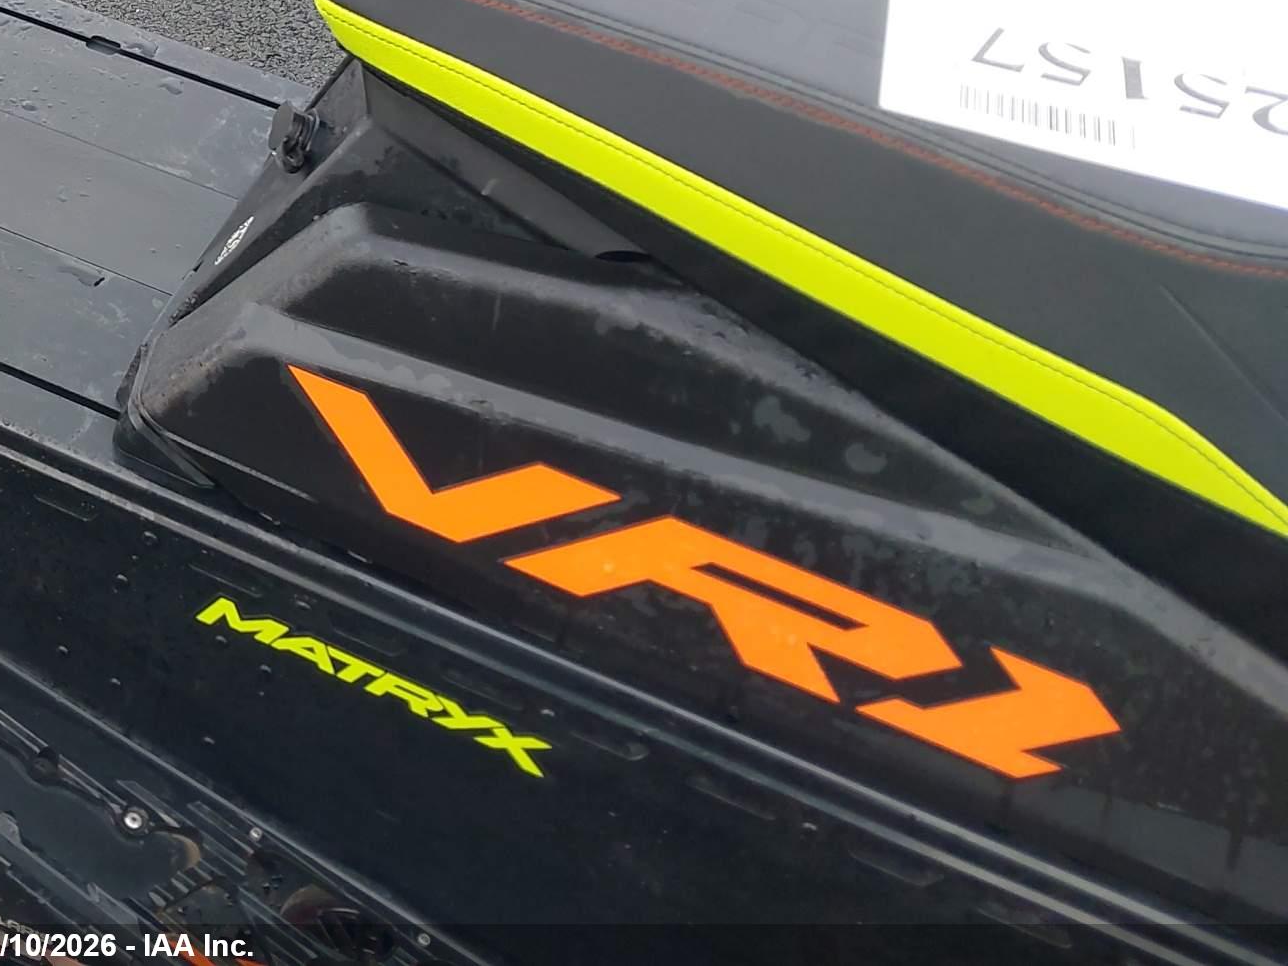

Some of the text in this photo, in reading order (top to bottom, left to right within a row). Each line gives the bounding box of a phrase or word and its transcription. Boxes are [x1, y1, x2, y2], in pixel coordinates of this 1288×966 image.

[971, 27, 1288, 136] 25157
[288, 365, 1120, 779] VR1
[196, 597, 552, 777] MATRYX
